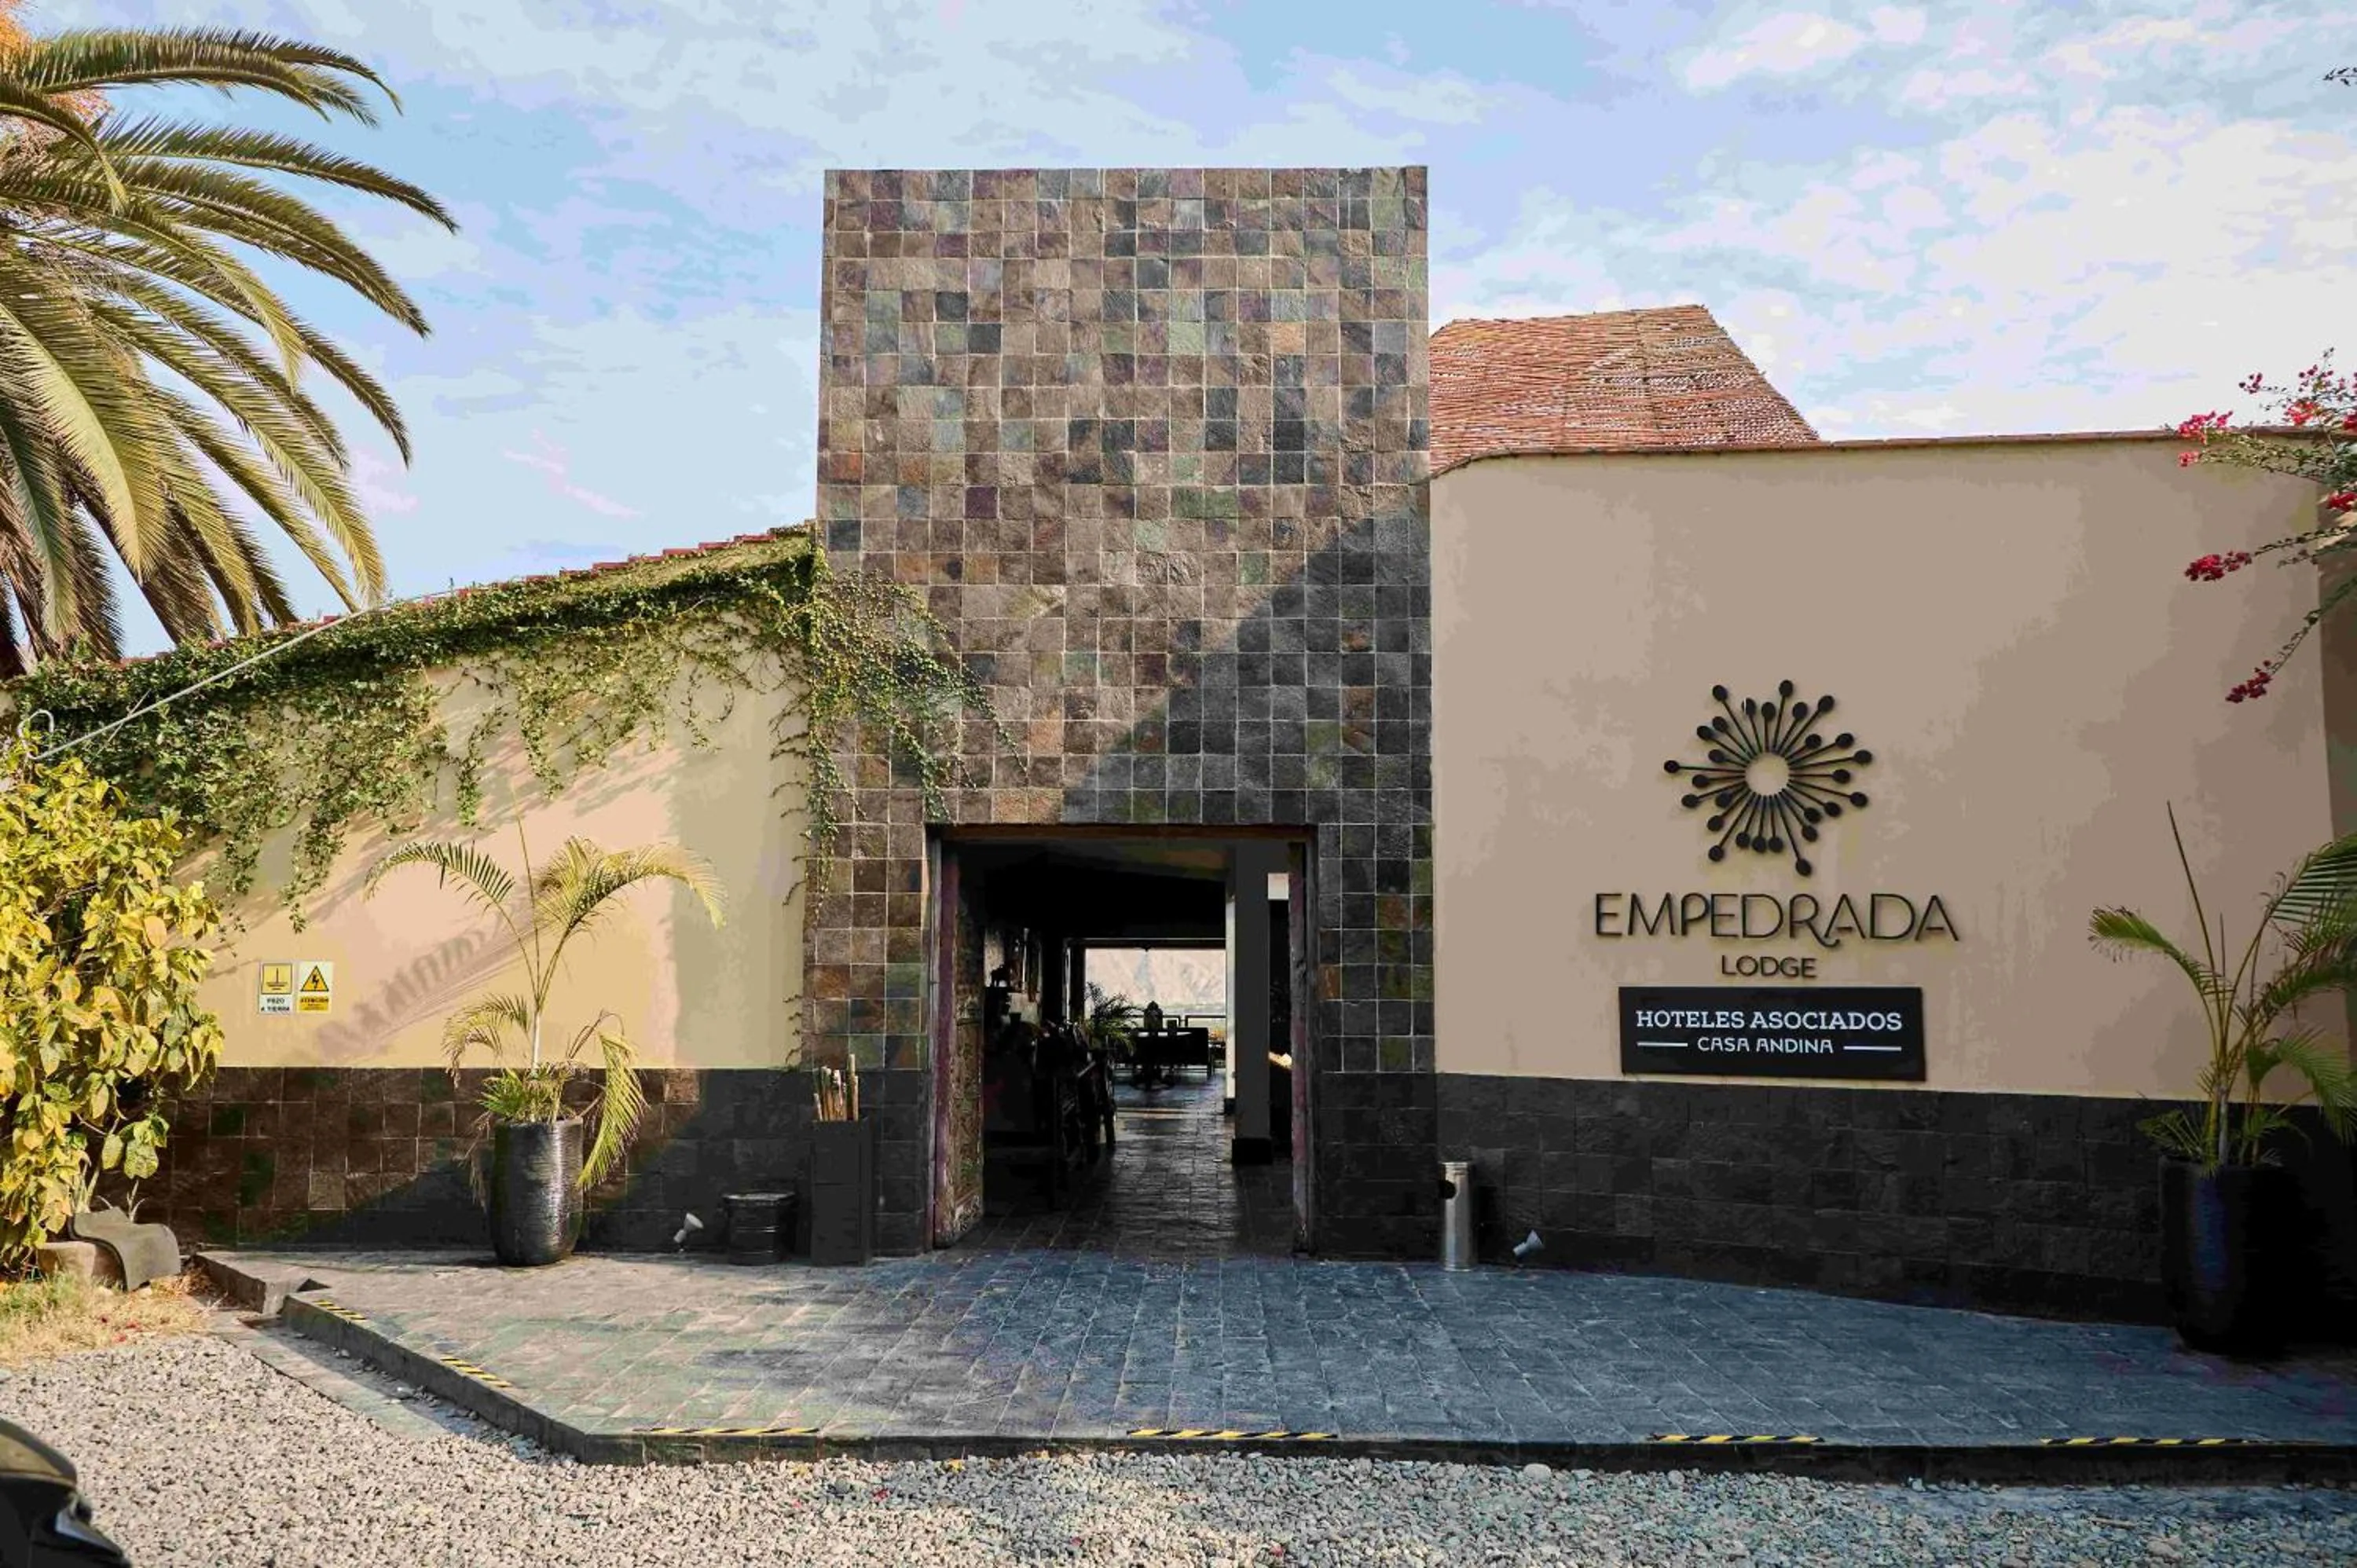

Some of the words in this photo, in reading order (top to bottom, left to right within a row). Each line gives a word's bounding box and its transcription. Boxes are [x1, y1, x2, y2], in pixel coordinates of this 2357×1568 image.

[1594, 892, 1959, 947] EMPEDRADA
[1721, 954, 1819, 978] LODGE
[1635, 1009, 1745, 1028] HOTELES
[1750, 1010, 1903, 1031] ASOCIADOS
[1697, 1036, 1750, 1053] CASA
[1755, 1037, 1834, 1054] ANDINA
